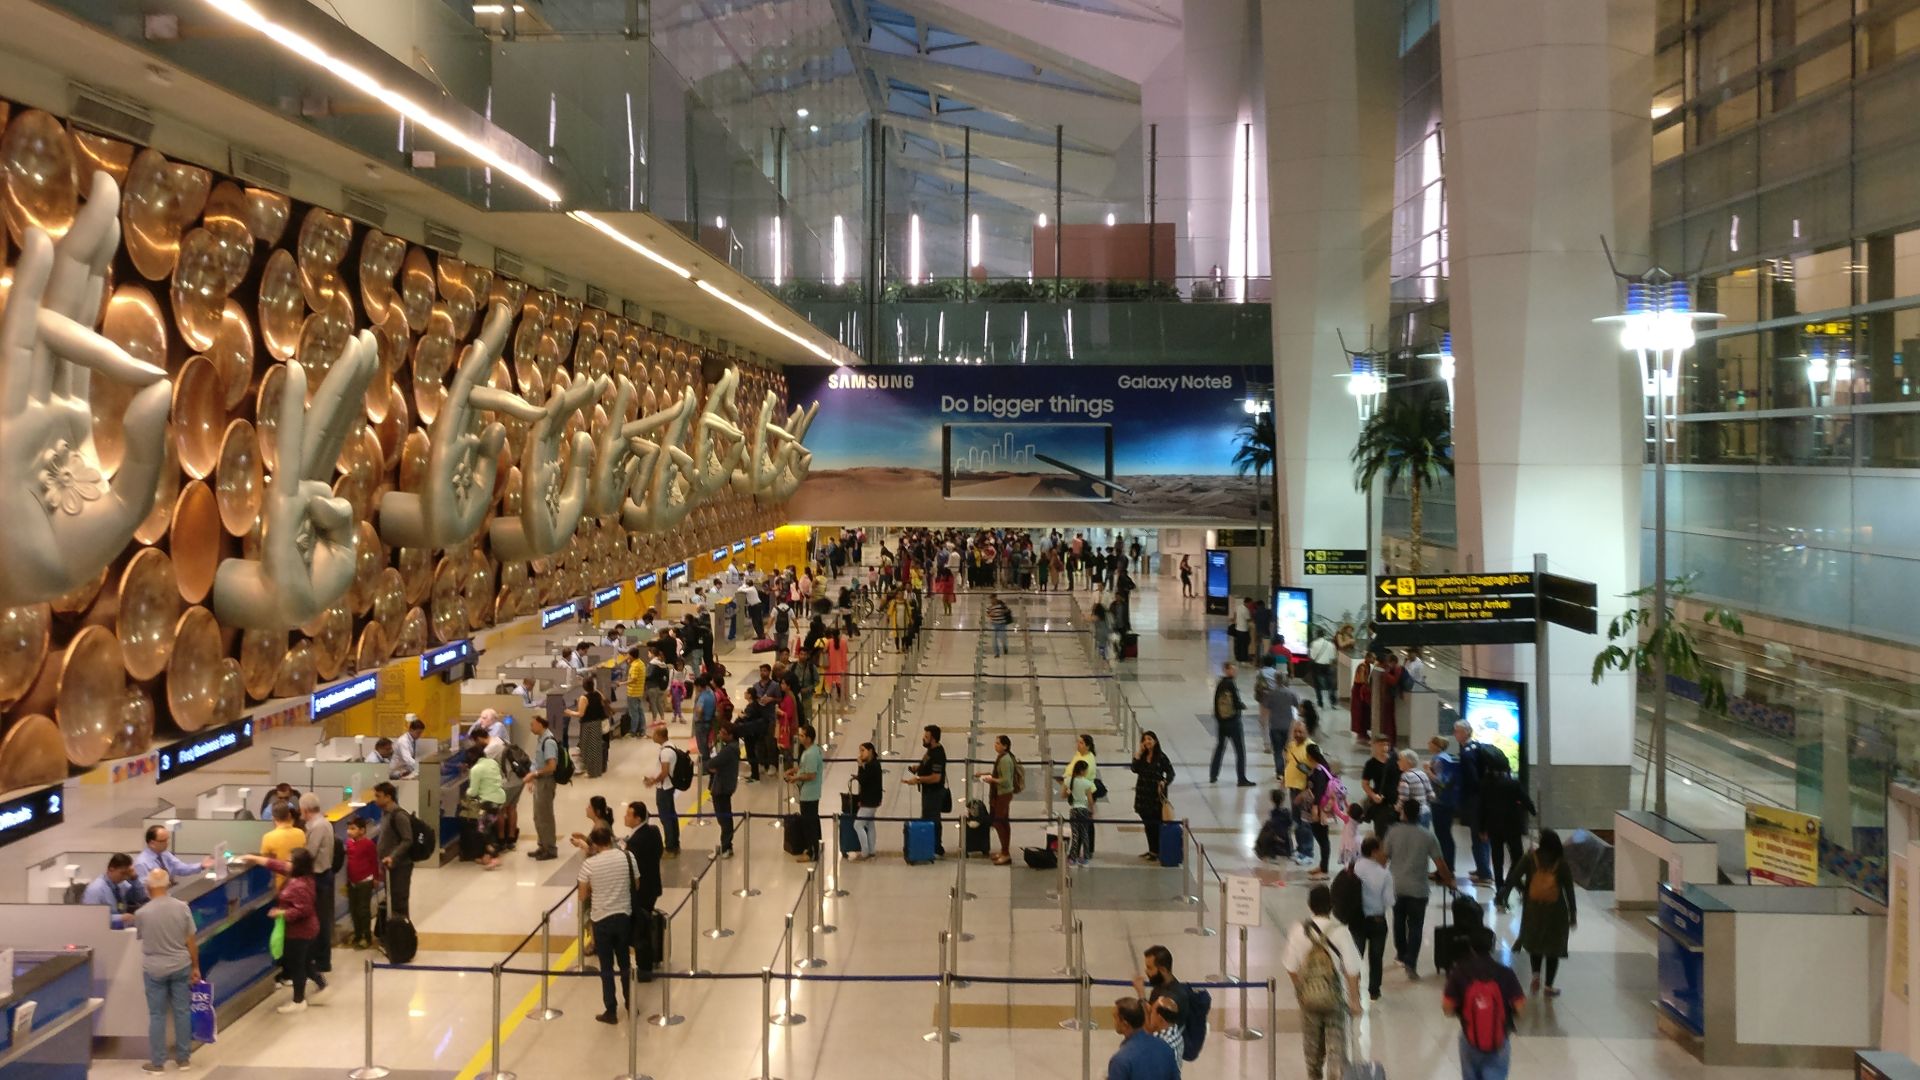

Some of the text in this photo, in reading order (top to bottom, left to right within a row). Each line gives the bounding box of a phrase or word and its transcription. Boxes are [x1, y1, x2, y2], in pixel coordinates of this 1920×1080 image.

[828, 374, 914, 389] SAMSUNG
[1118, 375, 1232, 392] Galaxy Note8
[941, 394, 1114, 419] Do bigger things
[161, 754, 171, 770] 3
[243, 722, 251, 737] 4
[49, 794, 60, 814] 2
